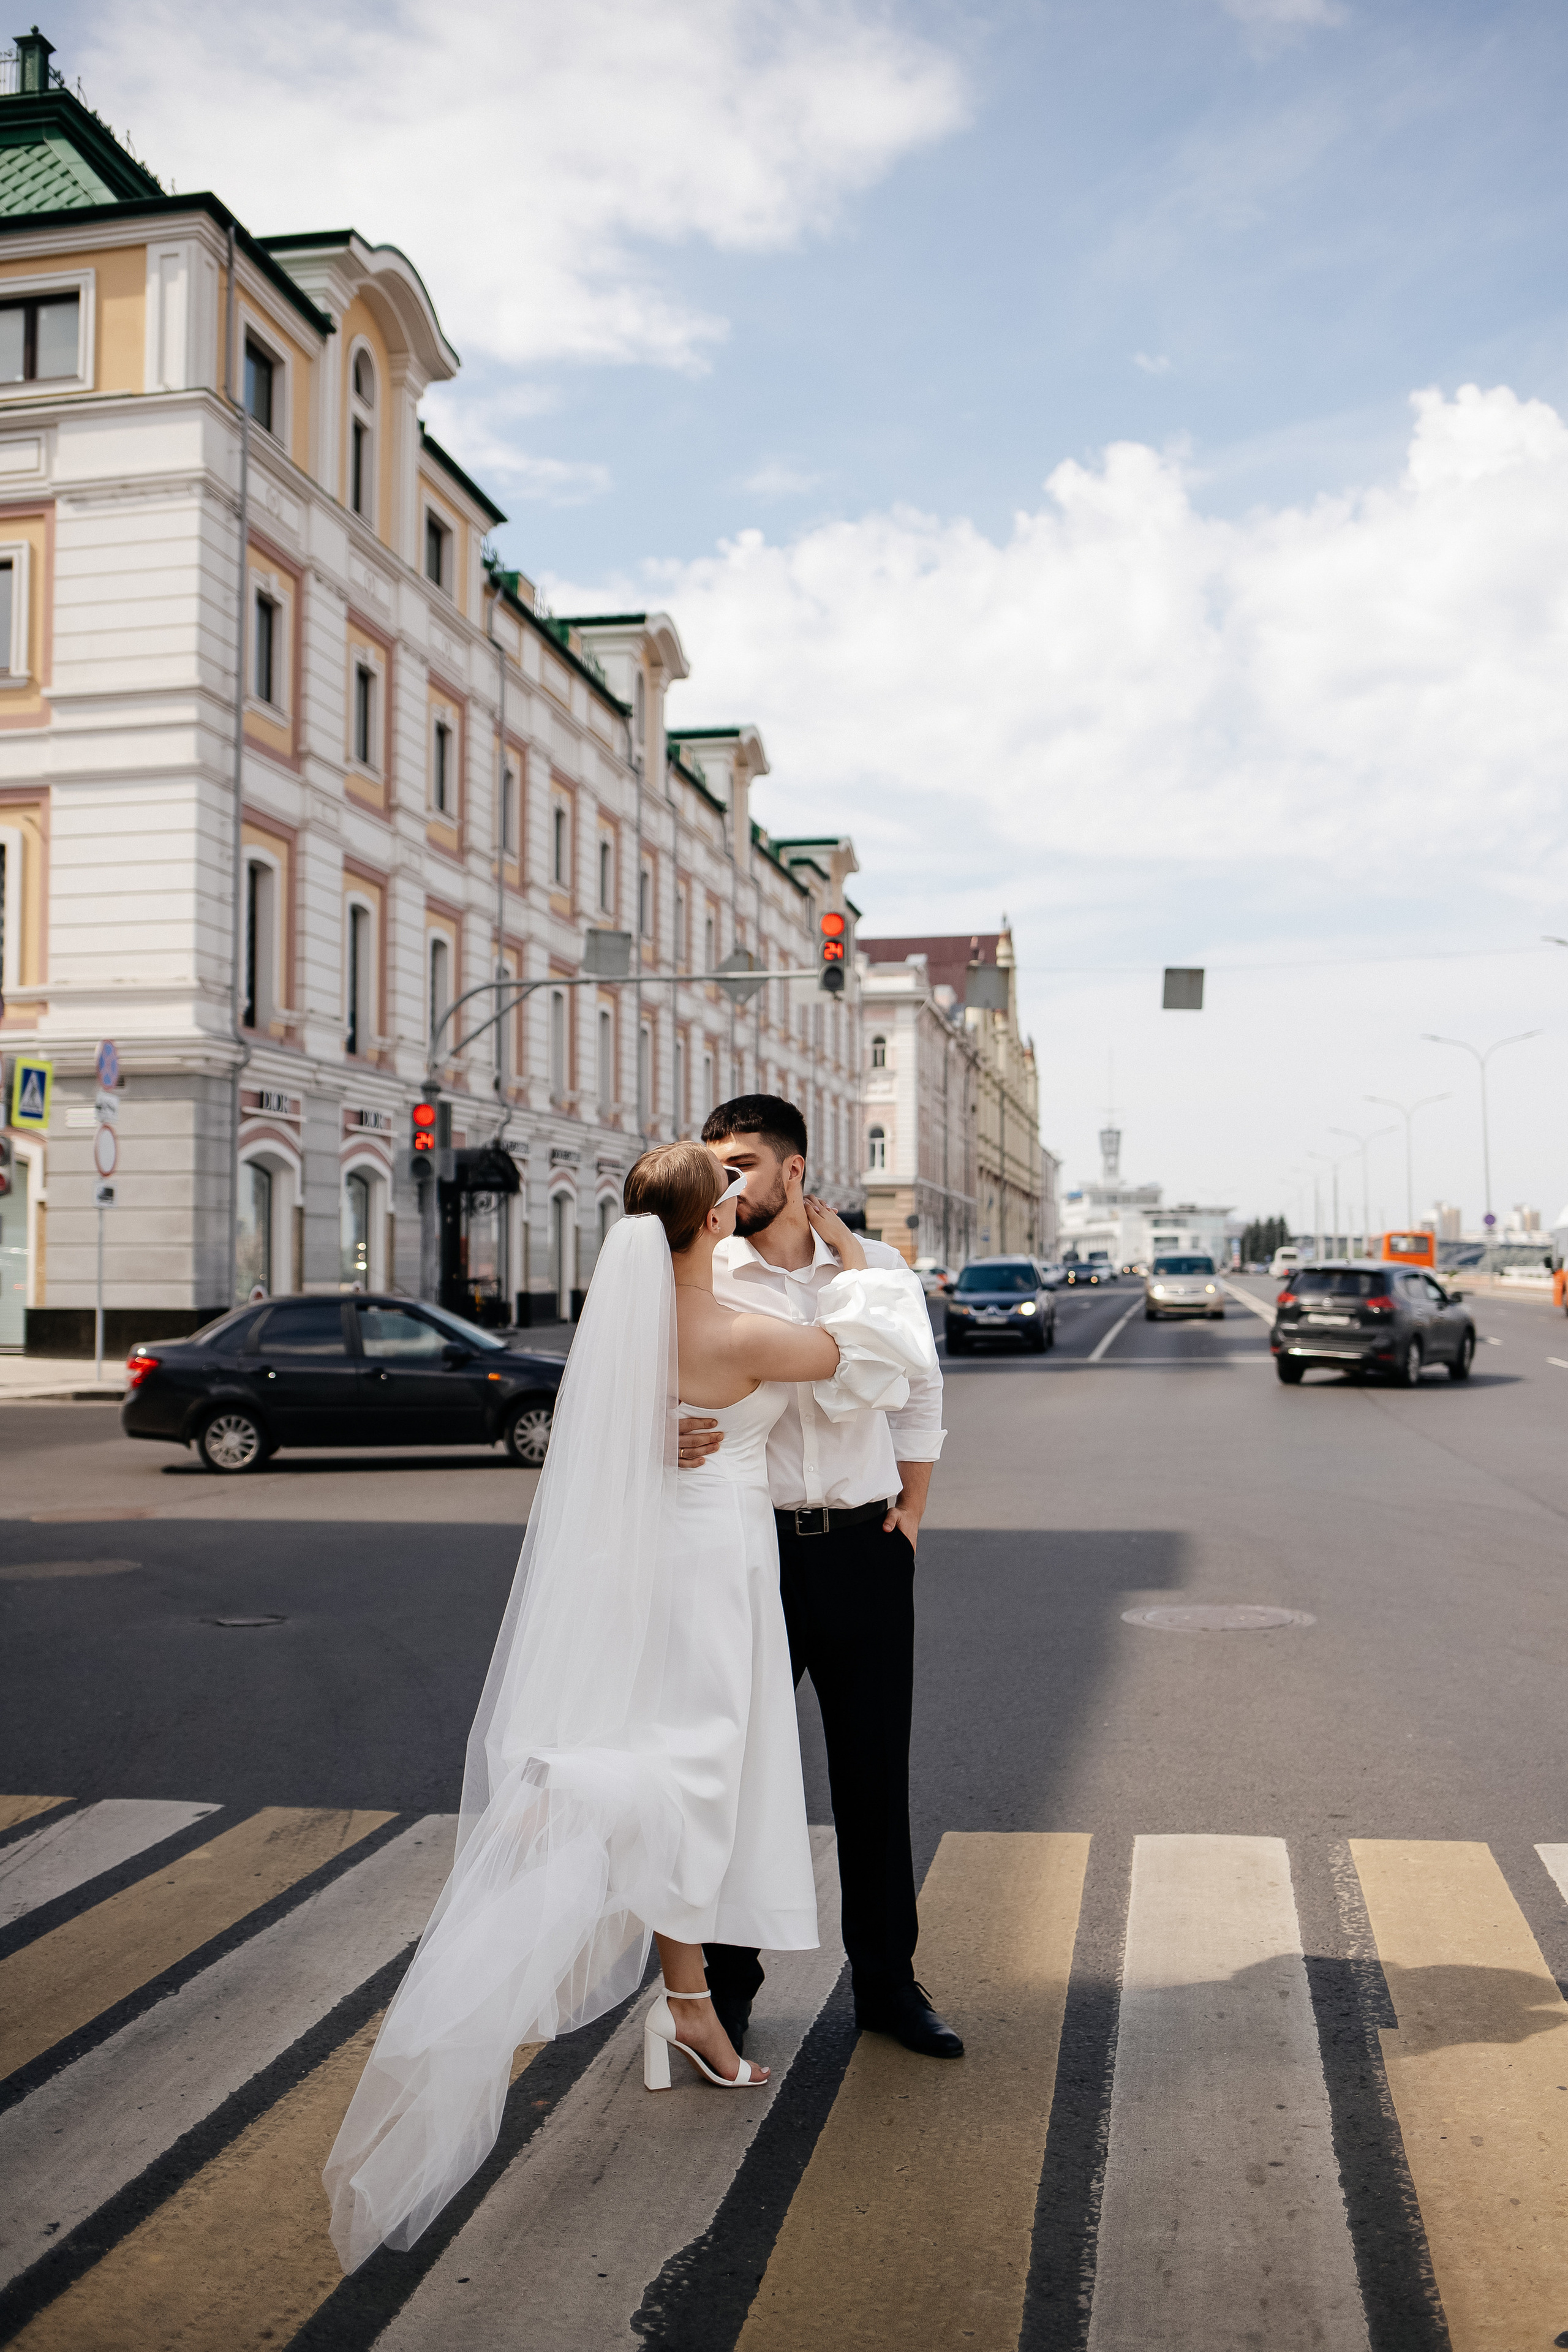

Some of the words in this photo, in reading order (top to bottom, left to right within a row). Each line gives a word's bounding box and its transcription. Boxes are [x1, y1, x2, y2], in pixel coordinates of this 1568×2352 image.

[824, 942, 843, 960] 24
[260, 1091, 290, 1114] DIOR
[361, 1110, 386, 1129] DIOR
[415, 1132, 435, 1150] 24
